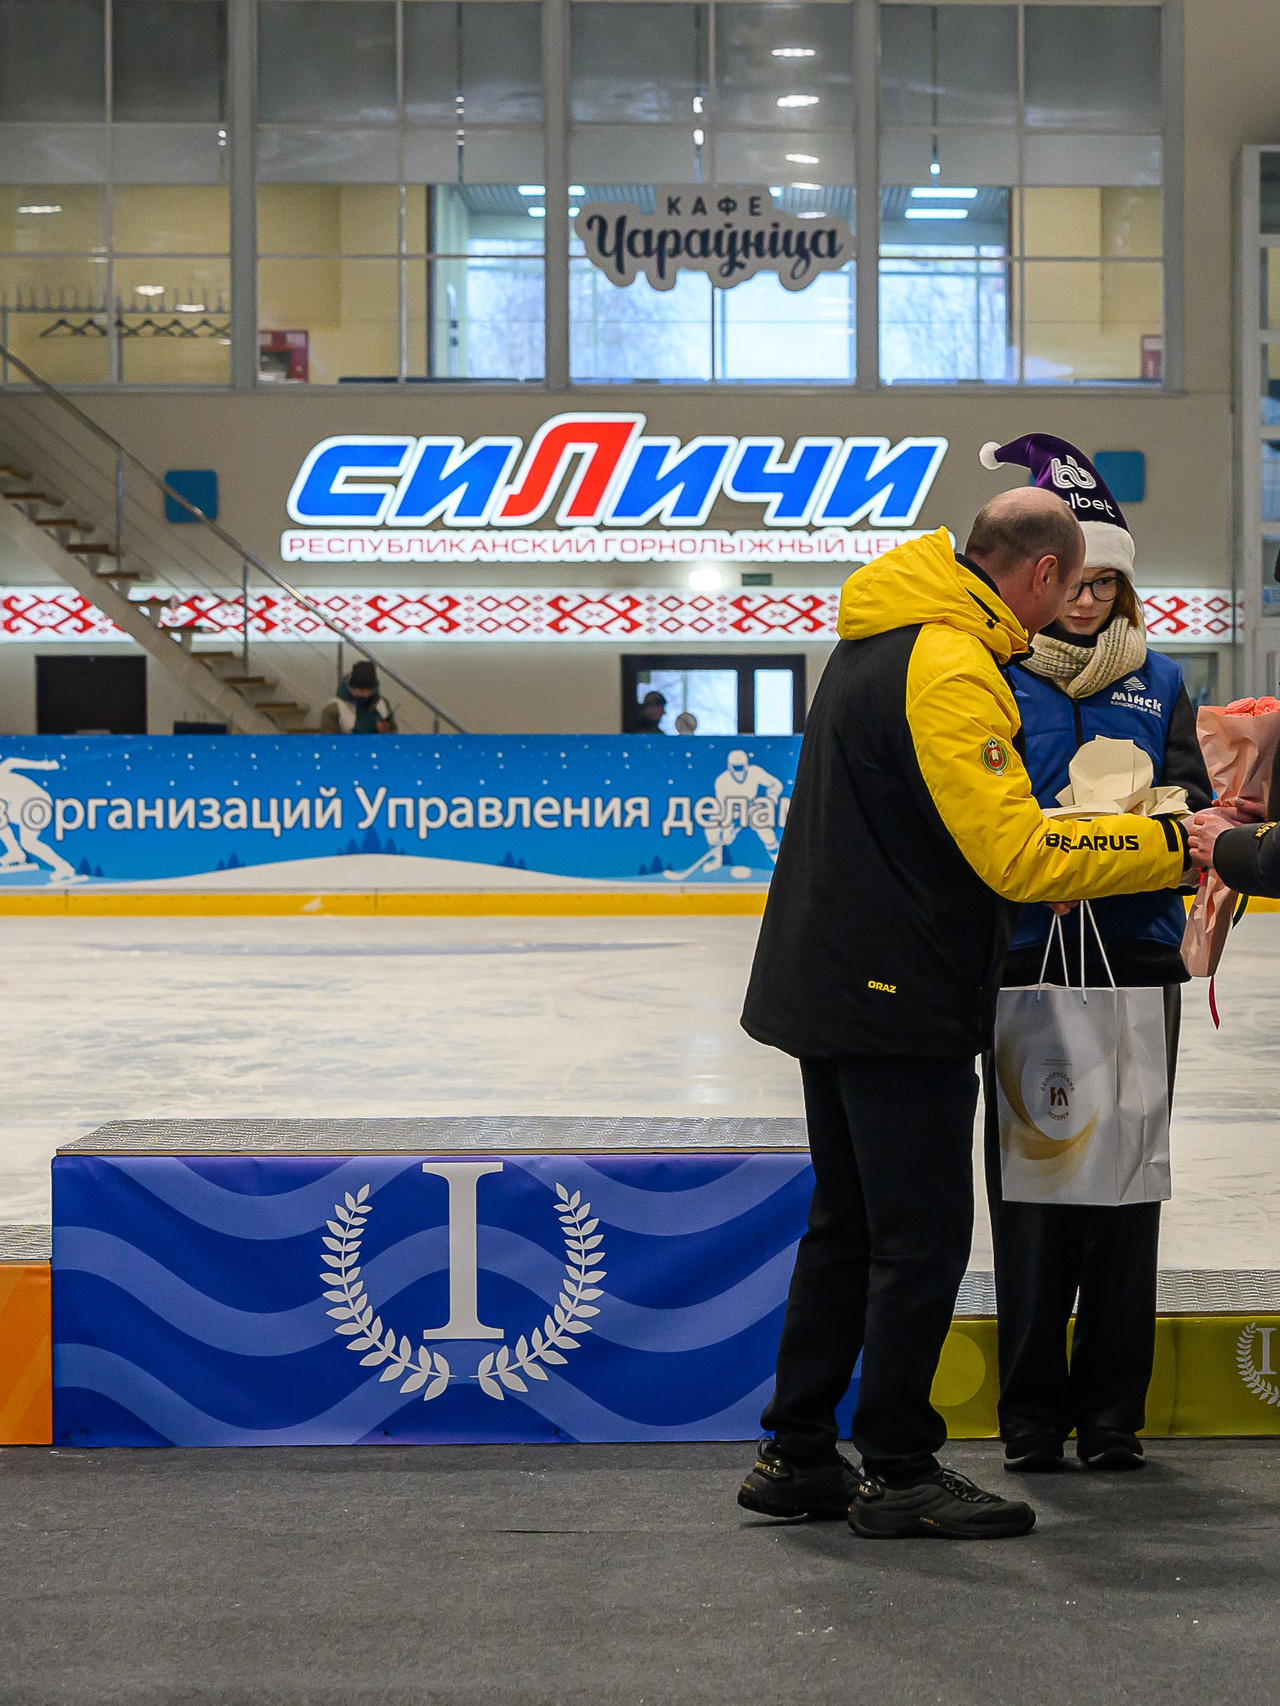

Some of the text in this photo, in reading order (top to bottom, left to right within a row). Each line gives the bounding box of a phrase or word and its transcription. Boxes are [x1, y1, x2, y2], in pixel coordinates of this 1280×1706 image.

[667, 196, 762, 216] КАФЕ
[586, 214, 843, 280] Чараўніца
[1063, 492, 1115, 518] lbet
[289, 533, 596, 554] РЕСПУБЛИКАНСКИЙ
[605, 533, 844, 554] ГОРНОЛЫЖНЫЙ
[21, 786, 343, 841] организаций
[356, 786, 650, 840] Управления
[1045, 833, 1140, 854] BELARUS
[867, 980, 897, 994] ORAZ
